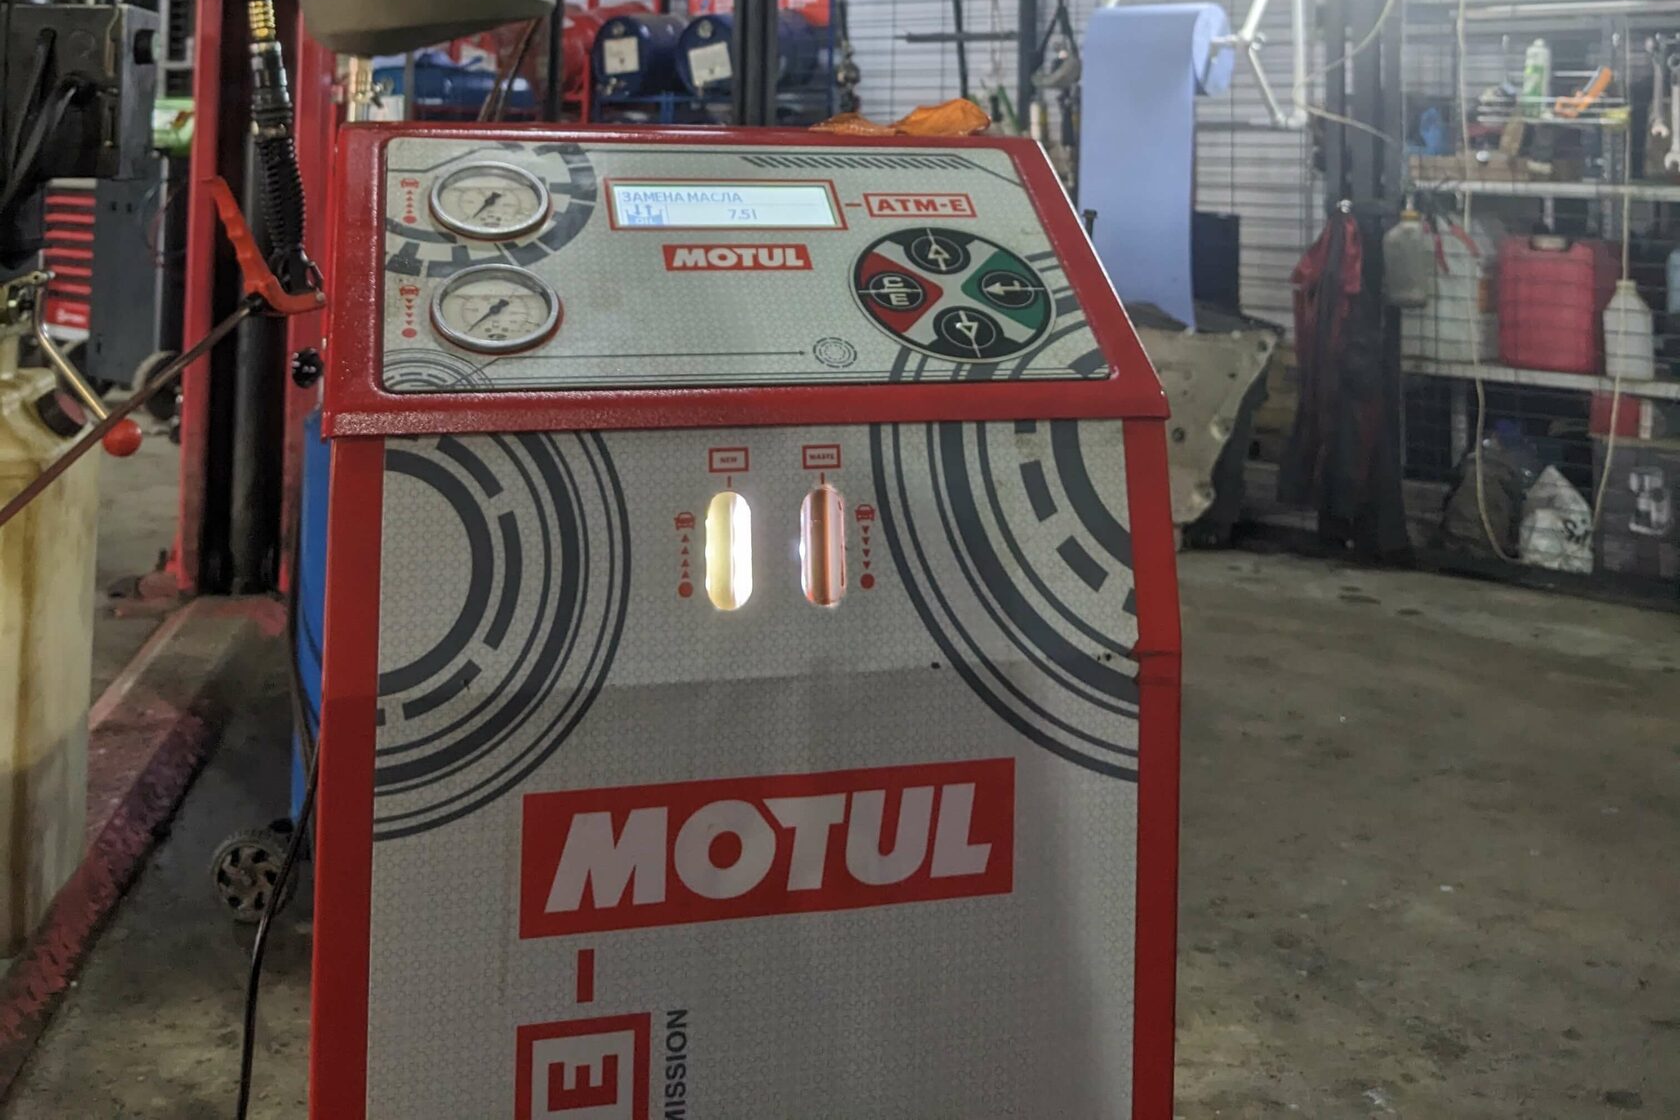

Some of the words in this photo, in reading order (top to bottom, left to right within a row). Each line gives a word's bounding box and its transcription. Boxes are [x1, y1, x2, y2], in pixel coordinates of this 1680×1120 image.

[622, 191, 683, 203] ЗАМЕНА
[689, 191, 743, 203] МАСЛА
[877, 198, 967, 213] ATM-E
[672, 247, 804, 268] MOTUL
[544, 782, 994, 915] MOTUL
